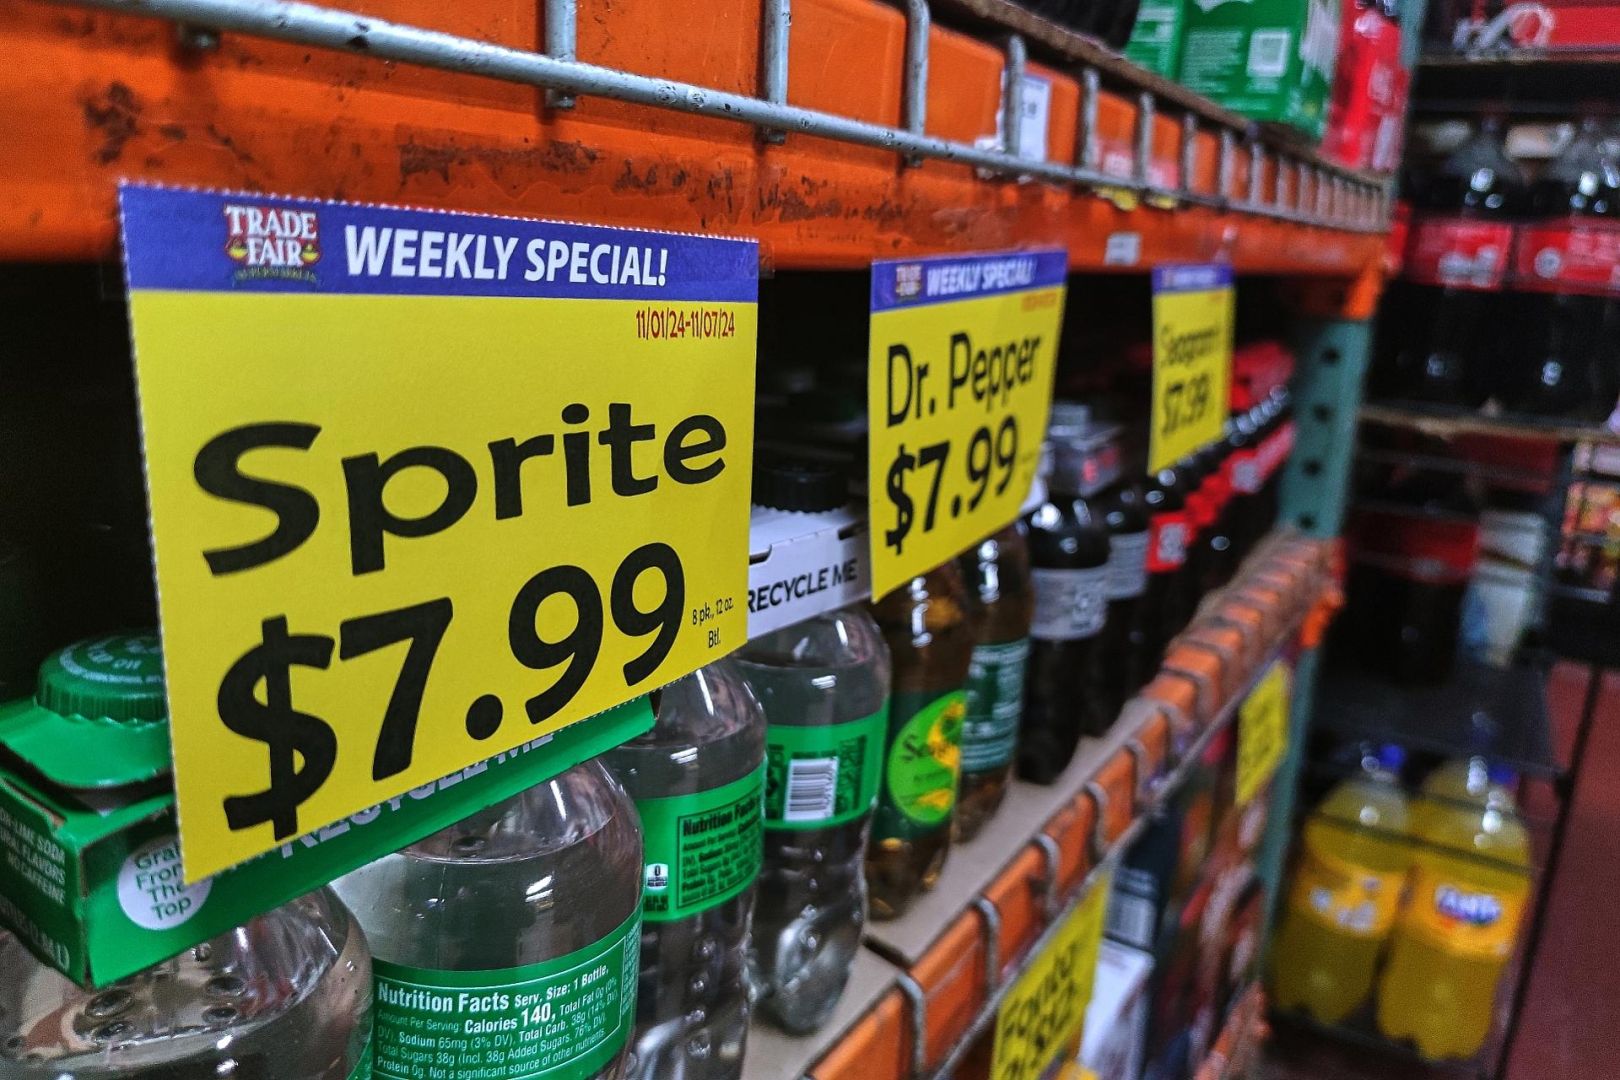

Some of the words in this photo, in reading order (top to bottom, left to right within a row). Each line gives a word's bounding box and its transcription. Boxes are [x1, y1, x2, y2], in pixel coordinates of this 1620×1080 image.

[224, 204, 317, 239] TRADE
[246, 237, 304, 266] FAIR
[344, 224, 519, 280] WEEKLY
[524, 238, 668, 287] SPECIAL!
[926, 263, 981, 297] WEEKLY
[636, 307, 735, 340] 11/01/24-11/07/24
[886, 343, 937, 429] Dr.
[948, 331, 1042, 412] Pepper
[192, 402, 728, 577] Sprite
[885, 415, 1019, 555] $7.99
[692, 609, 698, 625] 8
[715, 598, 723, 615] 12
[216, 541, 686, 842] $7.99
[683, 810, 733, 837] Nutrition
[151, 897, 192, 921] Top
[379, 981, 453, 1013] Nutrition
[458, 992, 510, 1013] Facts
[514, 994, 542, 1008] Serv.
[547, 983, 570, 1001] Size:
[573, 978, 579, 989] 1
[410, 1016, 425, 1028] Per
[464, 1017, 518, 1034] Calories
[521, 1002, 556, 1028] 140,
[560, 998, 580, 1016] Total
[583, 991, 595, 1006] Fat
[399, 1031, 436, 1047] Sodium
[438, 1037, 467, 1052] 65mg
[470, 1036, 491, 1051] (3%
[519, 1027, 542, 1042] Total
[545, 1020, 568, 1037] Carb.
[571, 1011, 586, 1026] 38g
[377, 1055, 409, 1074] Protein
[429, 1066, 446, 1079] Not
[449, 1069, 455, 1078] a
[457, 1065, 506, 1080] significant
[509, 1059, 540, 1075] source
[542, 1054, 551, 1066] of
[553, 1045, 573, 1063] other
[401, 1047, 433, 1063] Sugars
[436, 1051, 455, 1067] 38g
[486, 1050, 505, 1065] 38g
[508, 1043, 538, 1060] Added
